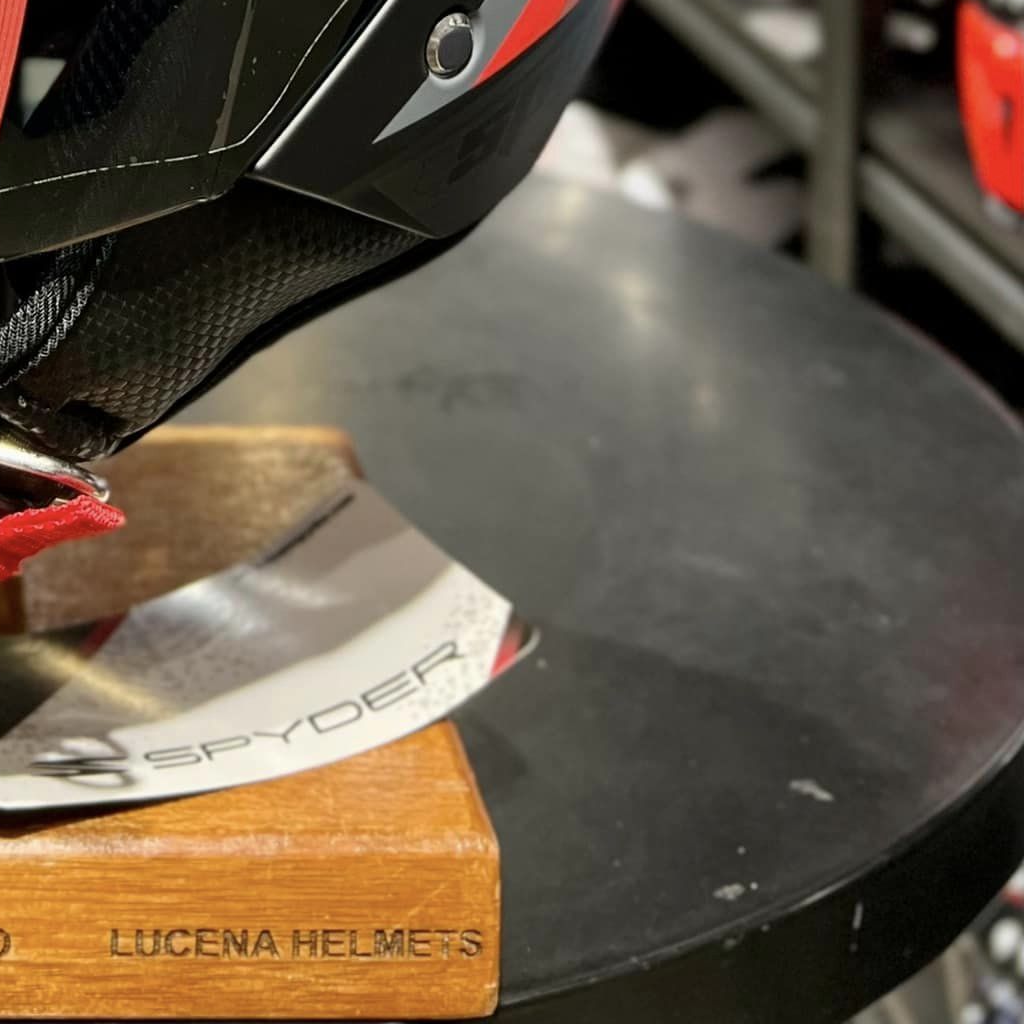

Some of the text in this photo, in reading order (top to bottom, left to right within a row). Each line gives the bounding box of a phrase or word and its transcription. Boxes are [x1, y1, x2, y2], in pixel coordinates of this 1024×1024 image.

[144, 640, 465, 769] SPYDER
[109, 928, 483, 958] LUCENA HELMETS
